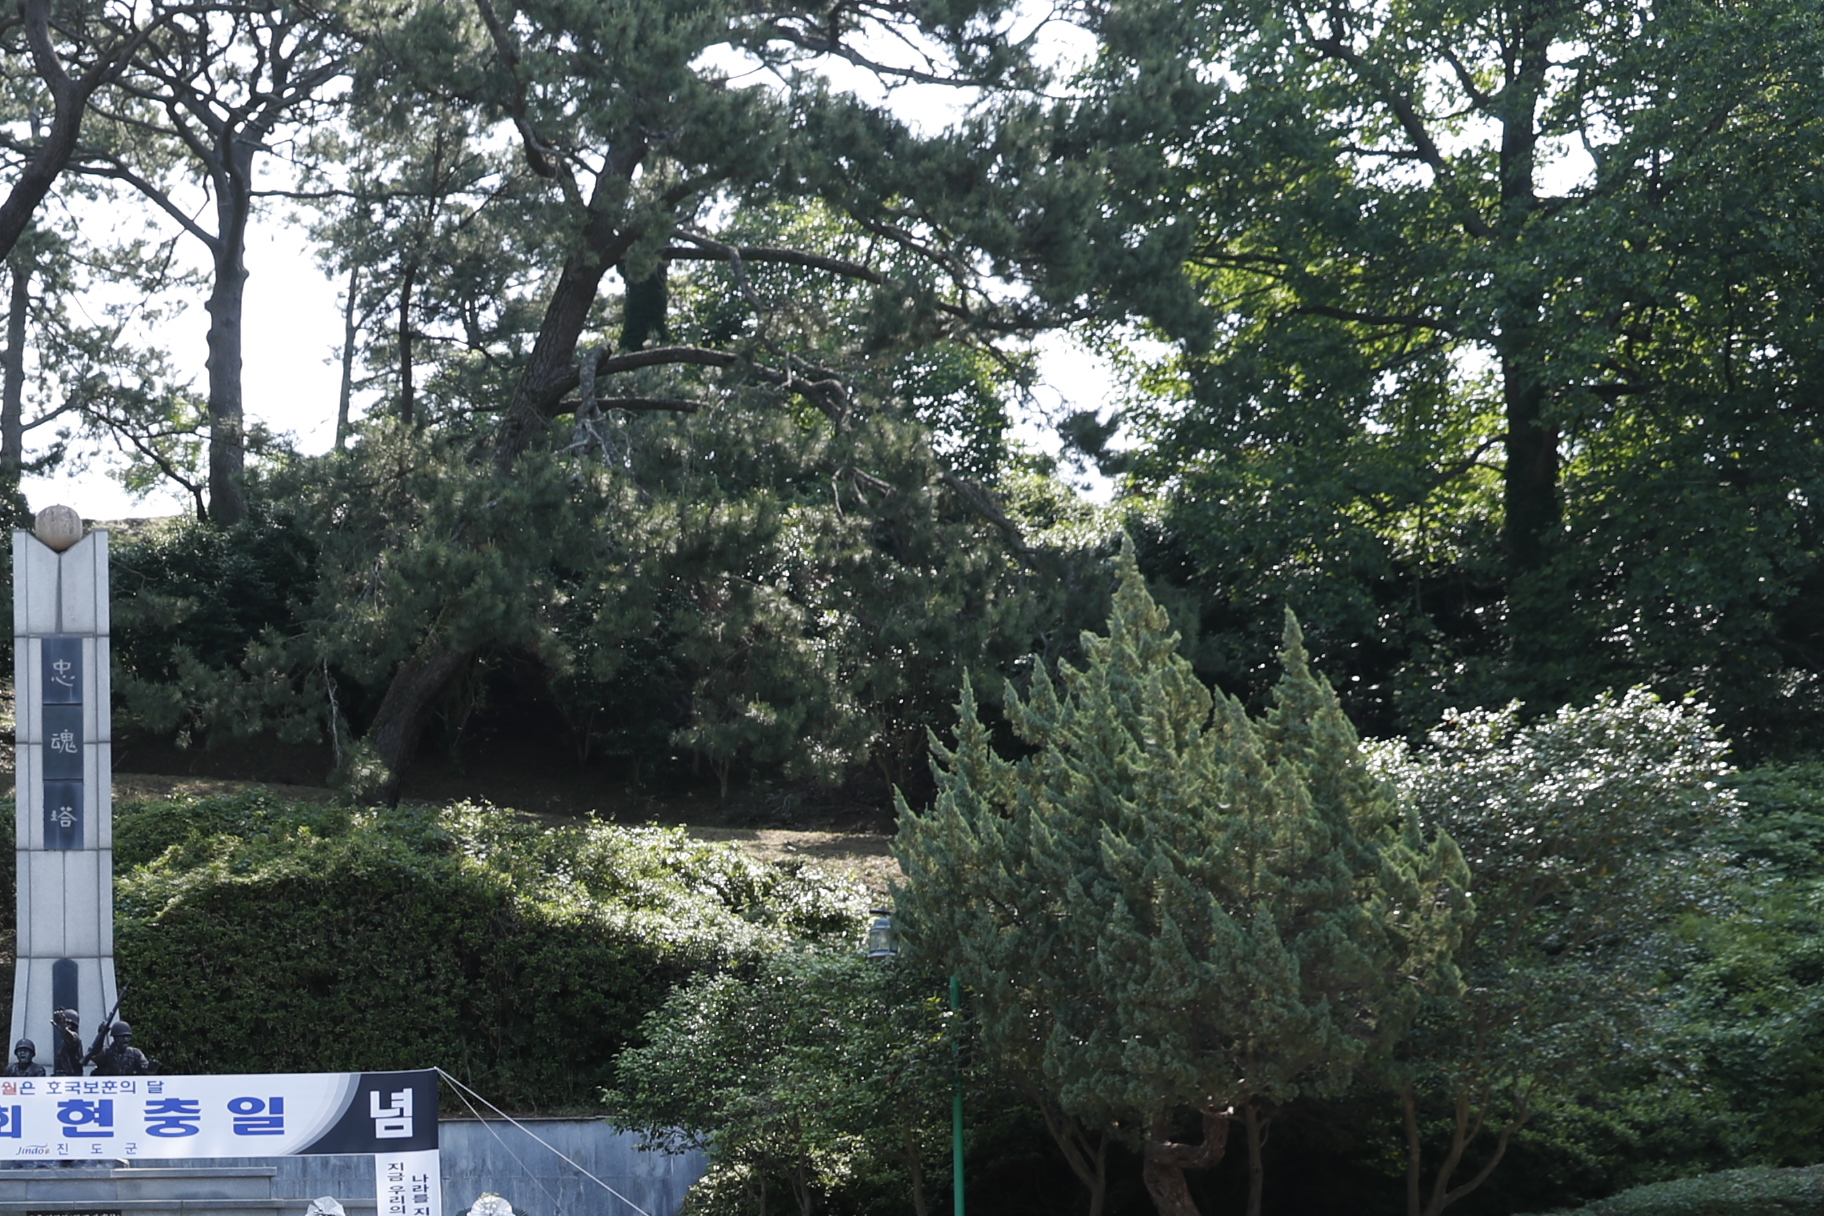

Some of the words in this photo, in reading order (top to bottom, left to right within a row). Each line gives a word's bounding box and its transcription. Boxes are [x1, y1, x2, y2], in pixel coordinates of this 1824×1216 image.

[50, 659, 78, 828] 忠魂塔
[46, 1080, 136, 1095] 호국보훈의
[147, 1080, 165, 1095] 달
[57, 1096, 285, 1138] 현충일
[370, 1087, 413, 1139] 념
[15, 1144, 46, 1156] Jindo
[57, 1143, 138, 1156] 진도군
[387, 1162, 405, 1182] 지금
[387, 1185, 406, 1214] 우리의
[412, 1173, 430, 1204] 나라를
